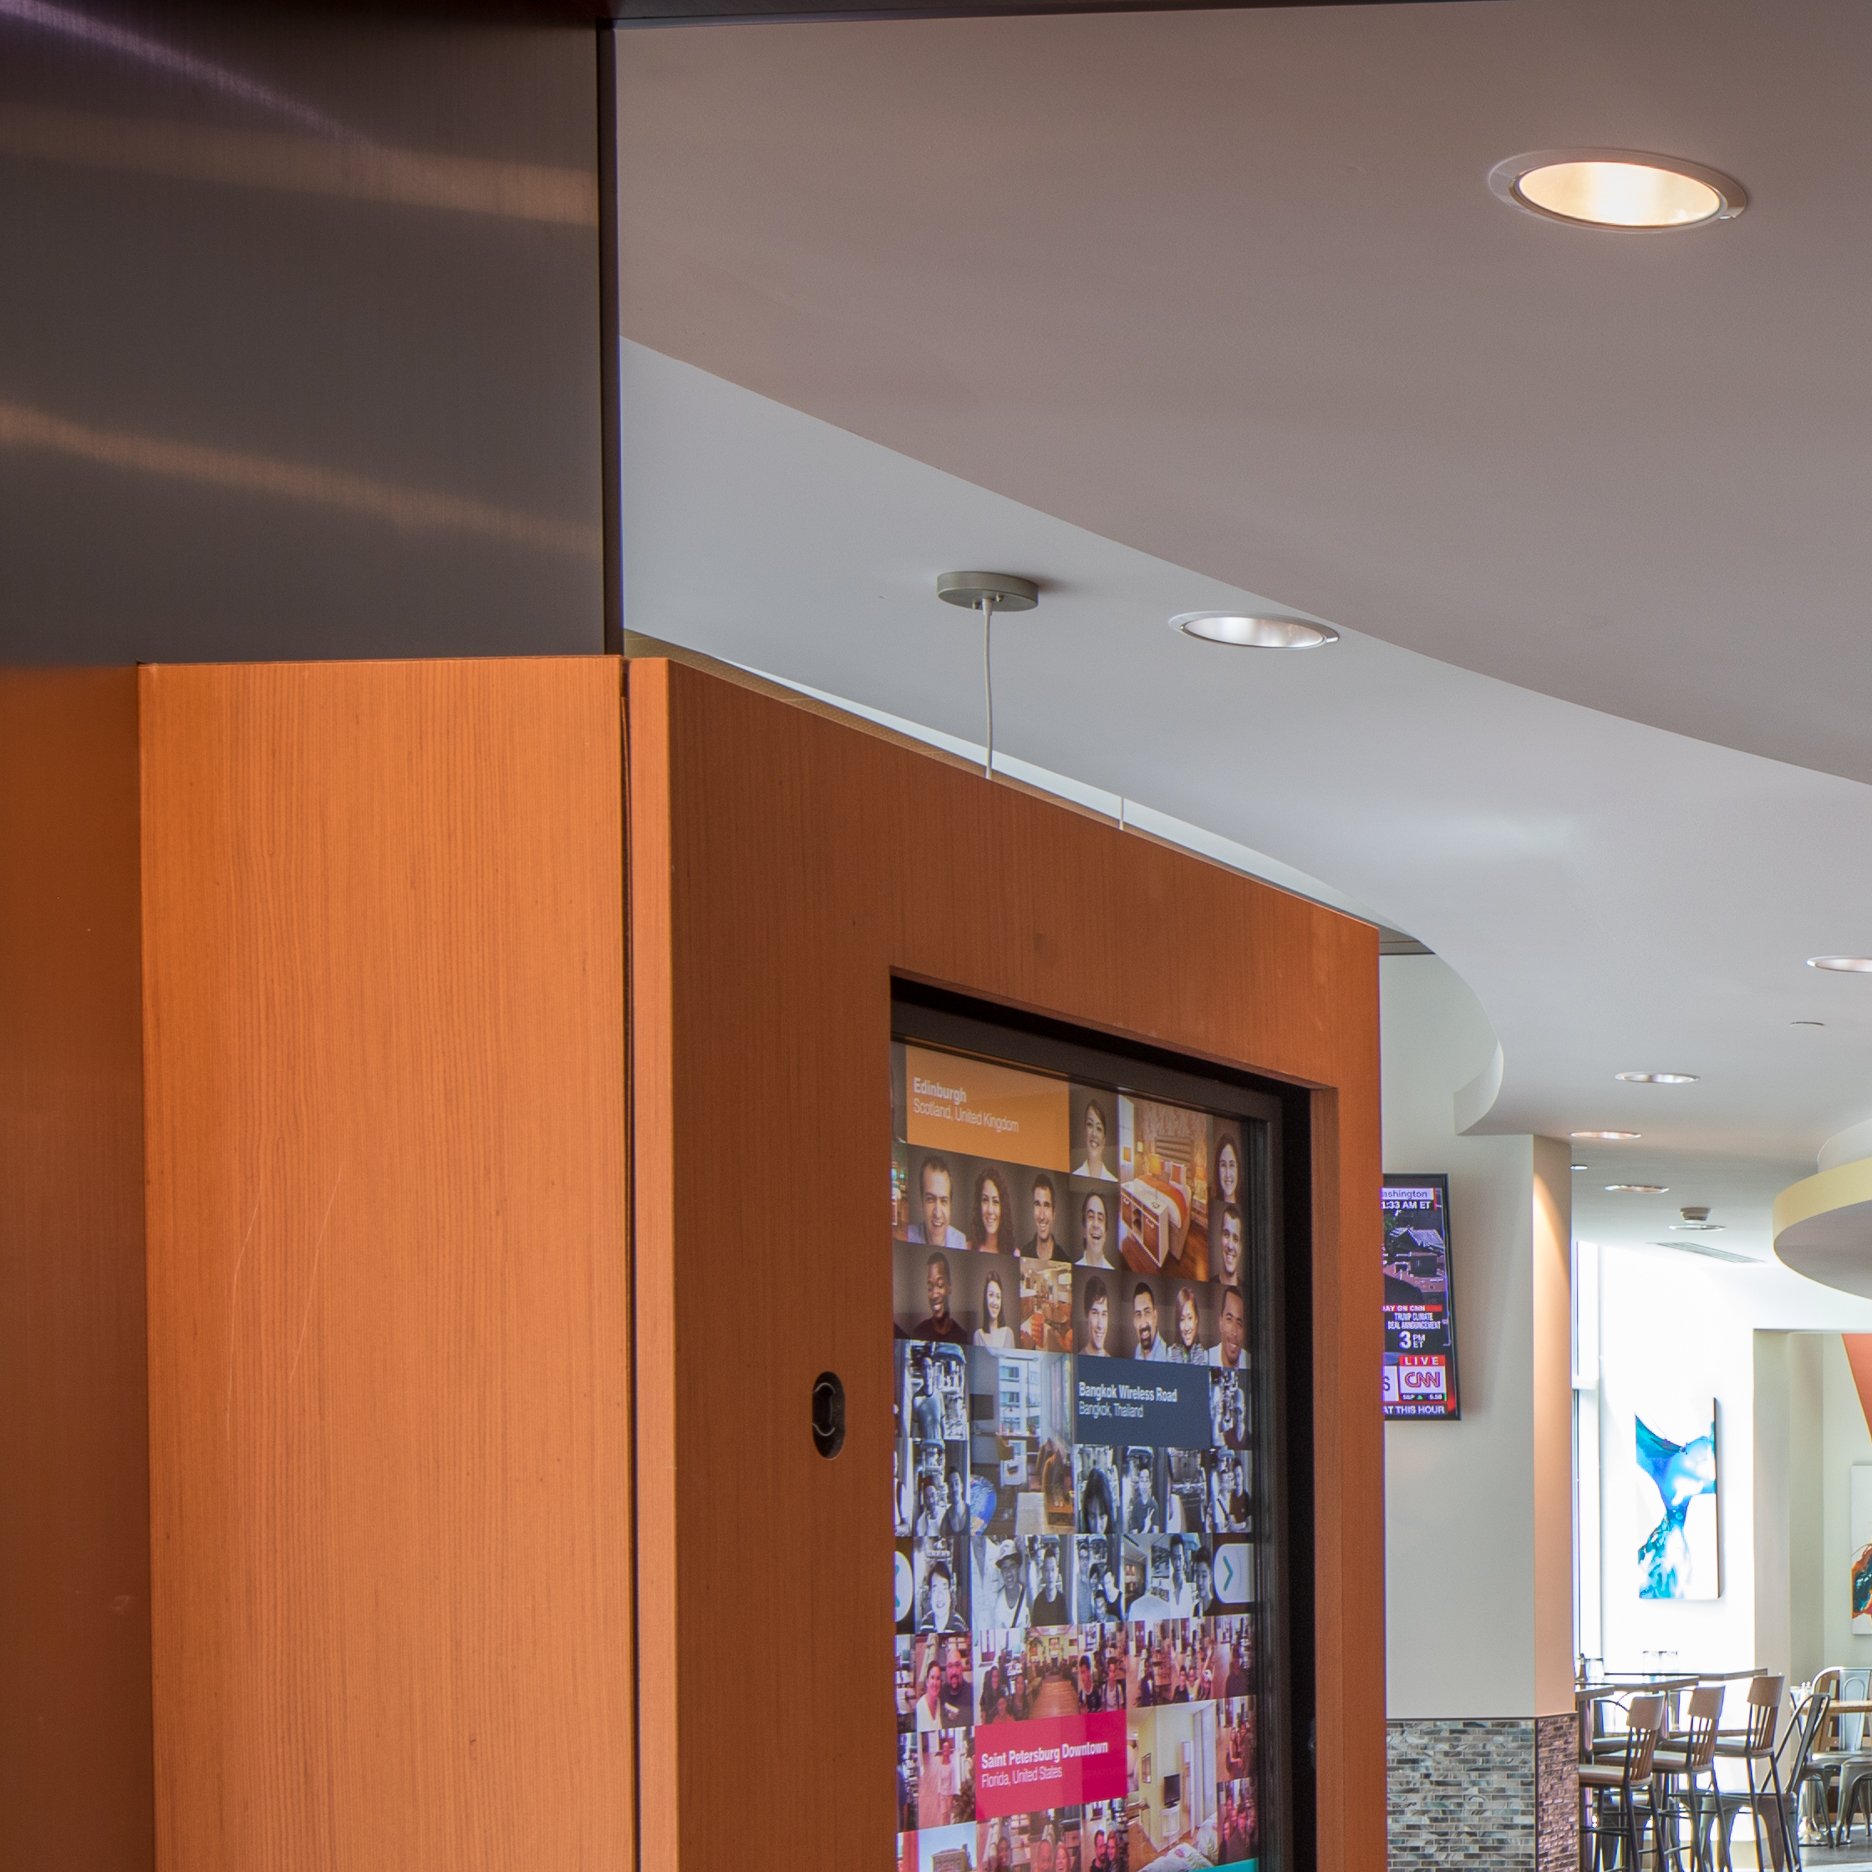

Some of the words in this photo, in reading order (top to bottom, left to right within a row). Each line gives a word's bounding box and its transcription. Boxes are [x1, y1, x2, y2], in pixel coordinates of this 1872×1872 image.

[913, 1077, 967, 1105] Edinburgh
[955, 1105, 982, 1125] United
[983, 1112, 1019, 1132] Kingdom
[1402, 1201, 1417, 1209] AM
[1420, 1201, 1431, 1209] ET
[1399, 1331, 1411, 1349] 3
[1404, 1356, 1439, 1365] LIVE
[1404, 1371, 1441, 1388] CNN
[1079, 1382, 1117, 1401] Bangkok
[1118, 1385, 1155, 1401] Wireless
[1156, 1387, 1177, 1402] Road
[1114, 1402, 1144, 1418] Thailand
[1396, 1406, 1417, 1414] THIS
[1418, 1406, 1445, 1414] HOUR
[981, 1752, 1007, 1769] Saint
[1008, 1747, 1061, 1765] Petersburg
[1062, 1741, 1108, 1759] Downtown
[1012, 1768, 1038, 1784] United
[1039, 1765, 1063, 1780] States
